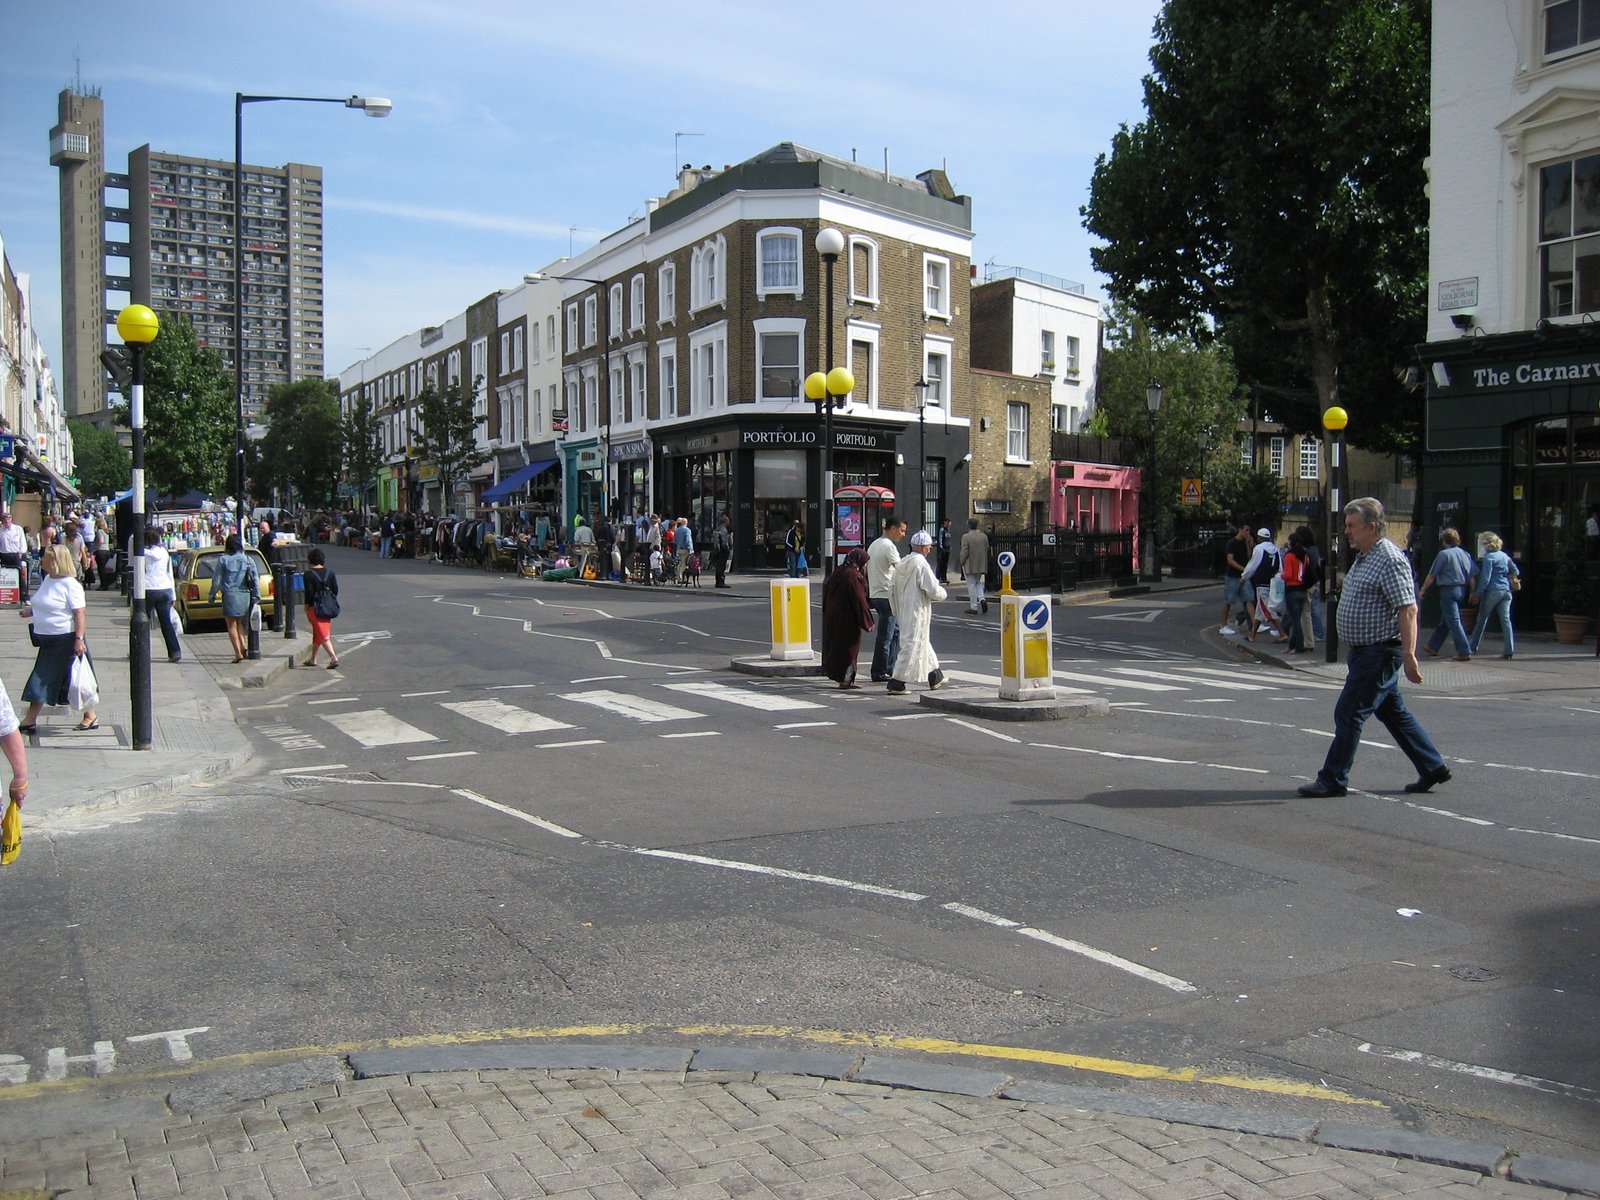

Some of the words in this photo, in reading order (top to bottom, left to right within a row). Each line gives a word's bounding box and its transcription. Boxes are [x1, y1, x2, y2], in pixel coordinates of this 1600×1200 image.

[1473, 368, 1511, 388] The
[687, 435, 712, 450] PORTFOLIO
[743, 431, 816, 443] PORTFOLIO
[836, 433, 877, 447] PORTFOLIO
[740, 502, 751, 510] 105
[844, 518, 860, 534] 2p
